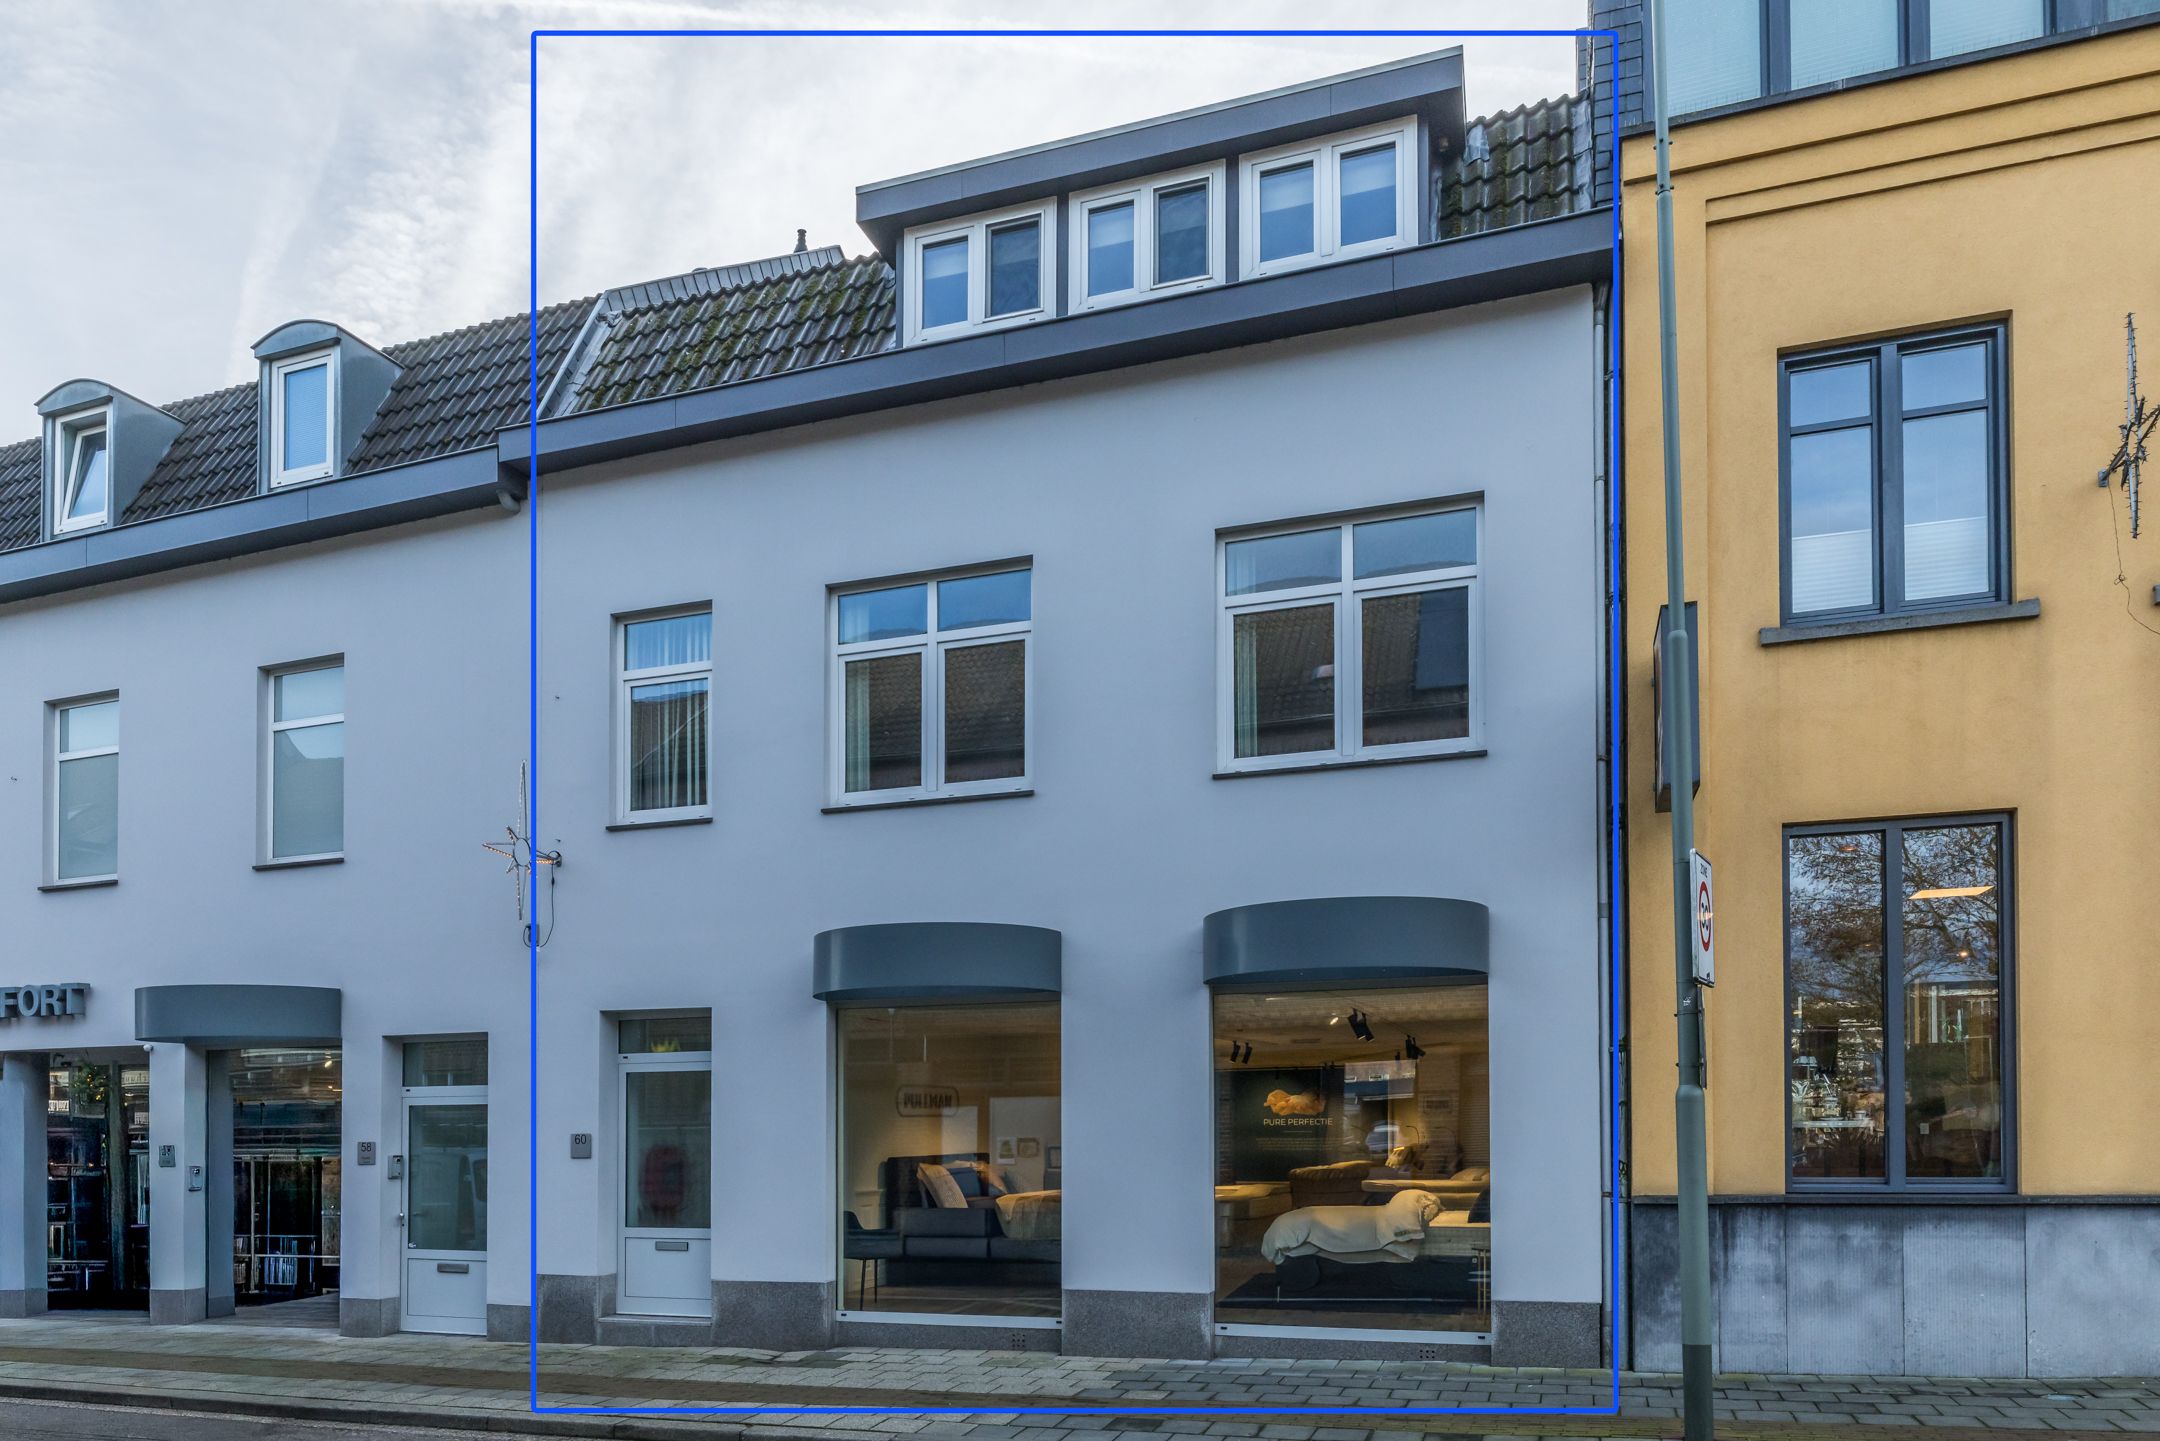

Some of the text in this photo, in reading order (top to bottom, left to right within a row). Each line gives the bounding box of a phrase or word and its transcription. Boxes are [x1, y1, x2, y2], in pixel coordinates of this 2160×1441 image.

[0, 983, 90, 1018] FORT
[1263, 1117, 1333, 1126] PURE PERFECTIE
[574, 1133, 587, 1145] 60
[361, 1142, 372, 1152] 58
